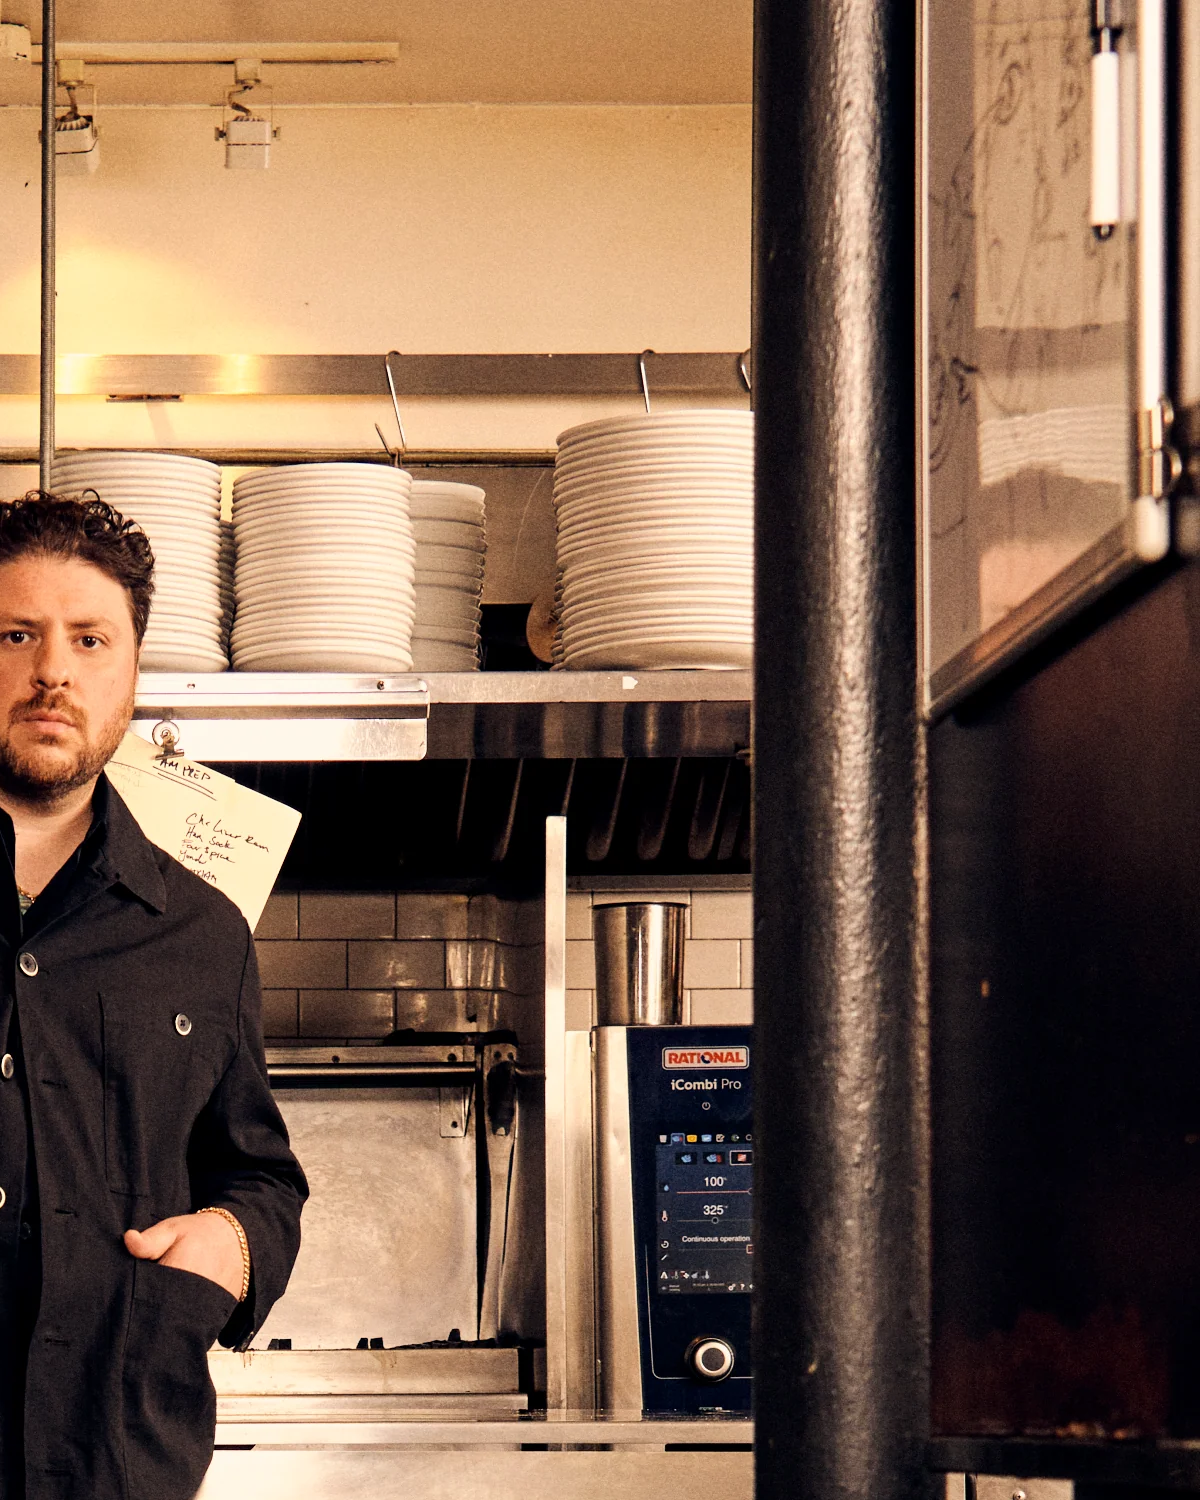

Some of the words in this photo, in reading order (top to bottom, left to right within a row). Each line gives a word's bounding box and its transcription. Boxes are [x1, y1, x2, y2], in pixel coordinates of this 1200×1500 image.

[160, 759, 179, 770] AM
[183, 765, 211, 780] PREP
[668, 1052, 744, 1064] RATIONAL
[671, 1079, 718, 1091] iCombi
[721, 1078, 742, 1090] Pro
[681, 1235, 719, 1243] Continuous
[719, 1234, 751, 1243] operation
